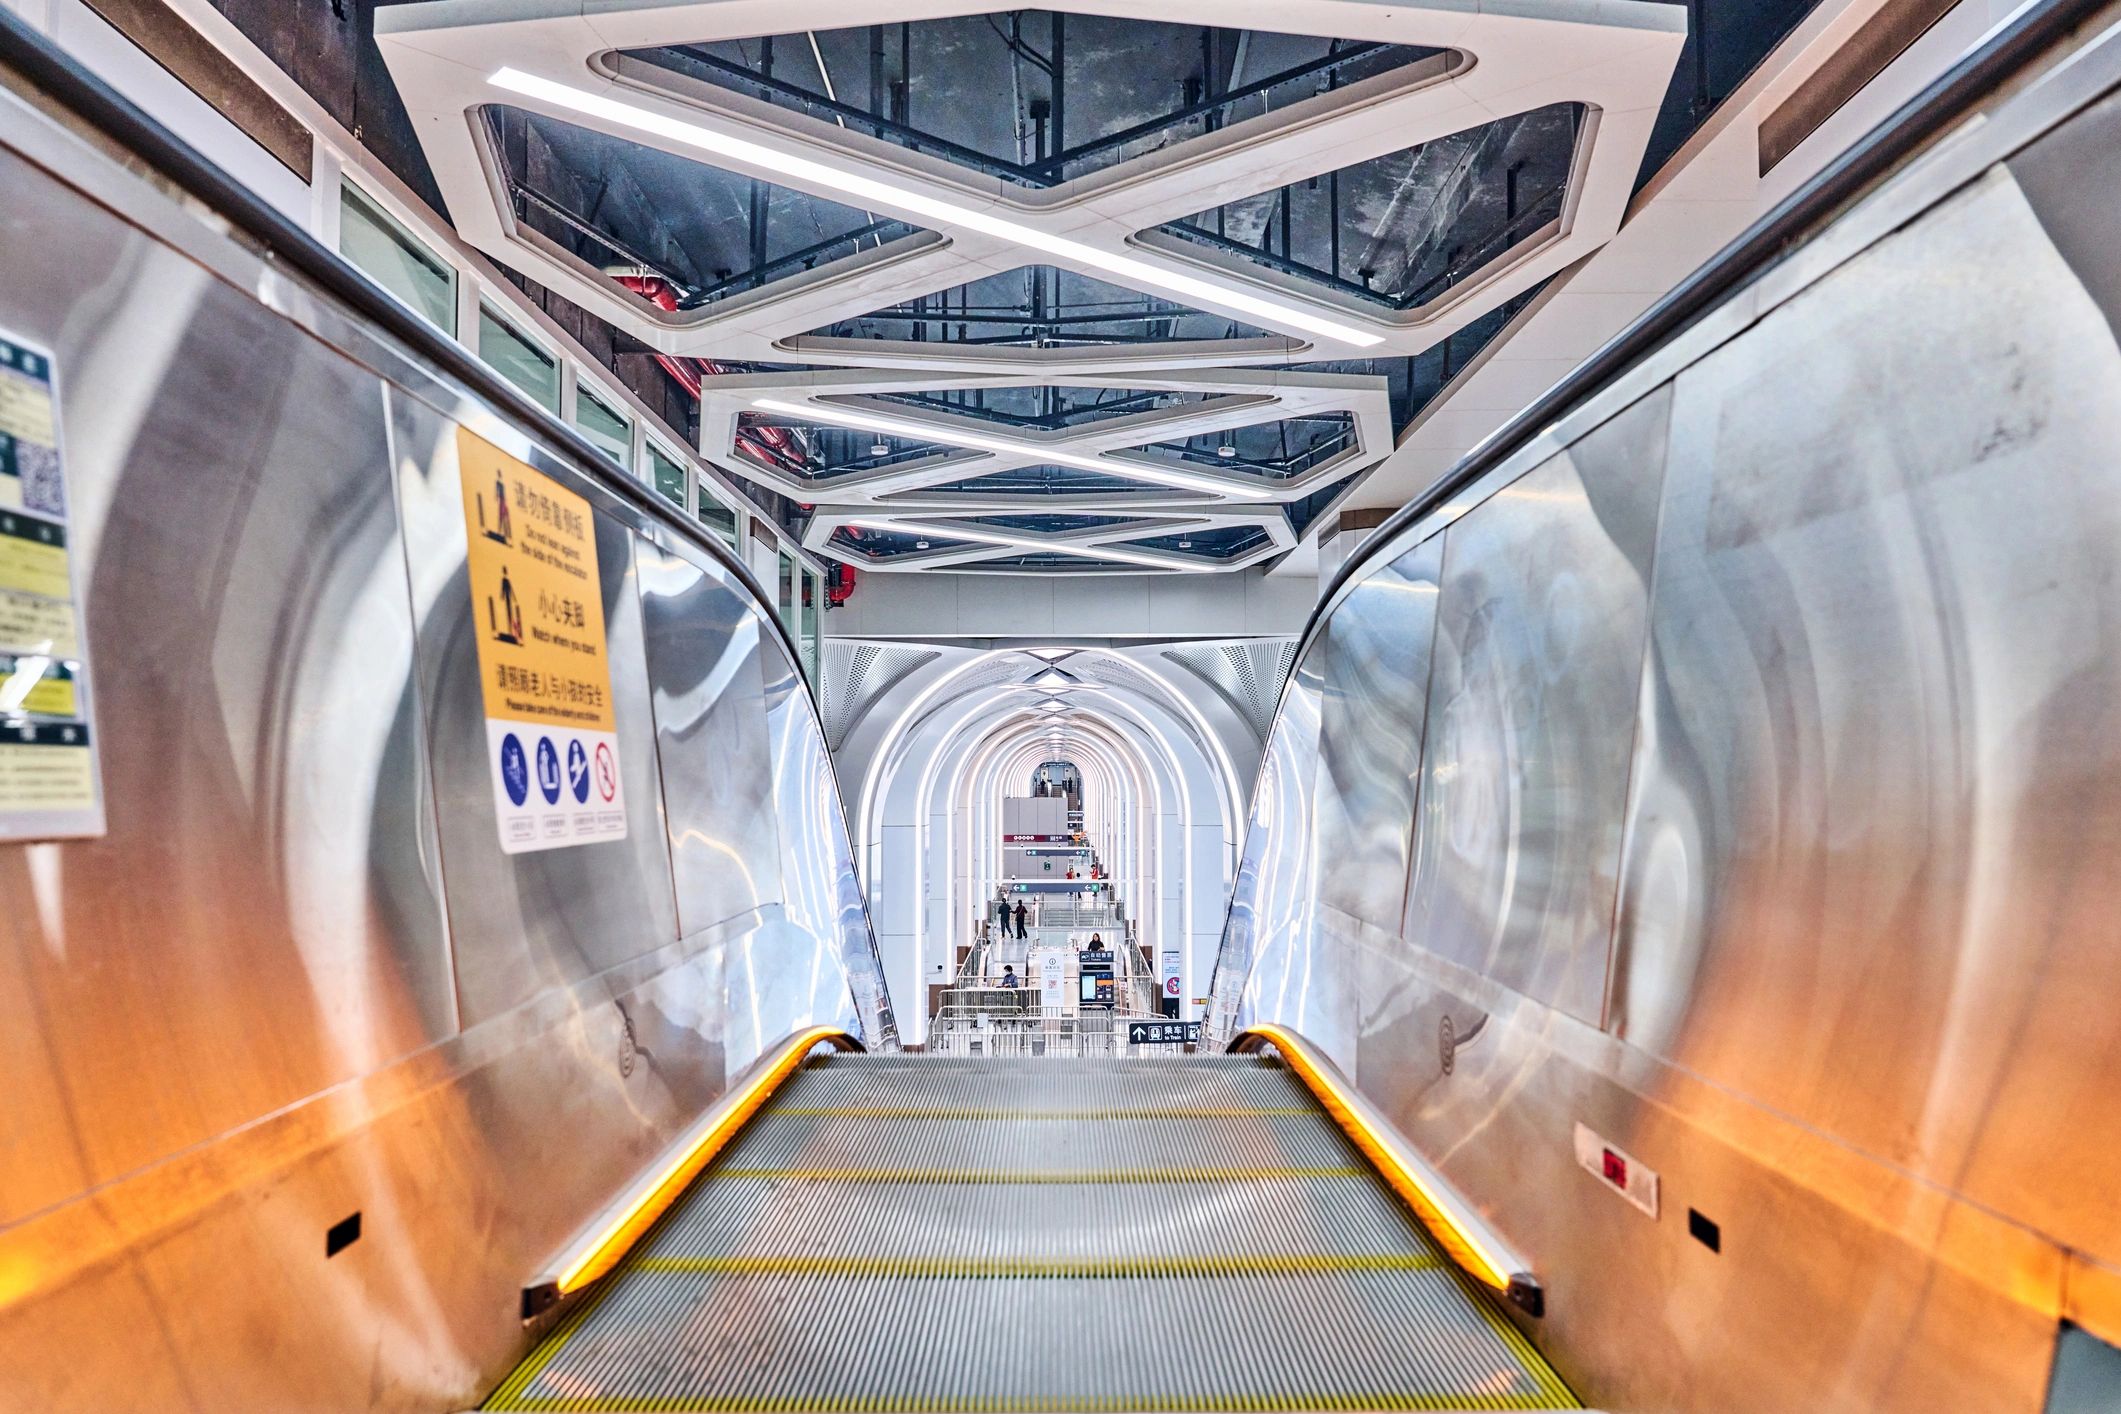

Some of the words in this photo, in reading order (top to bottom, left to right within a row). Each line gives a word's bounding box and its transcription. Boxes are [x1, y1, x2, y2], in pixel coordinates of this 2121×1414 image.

[538, 588, 585, 628] 小心夹脚
[1164, 1025, 1182, 1035] 乘车
